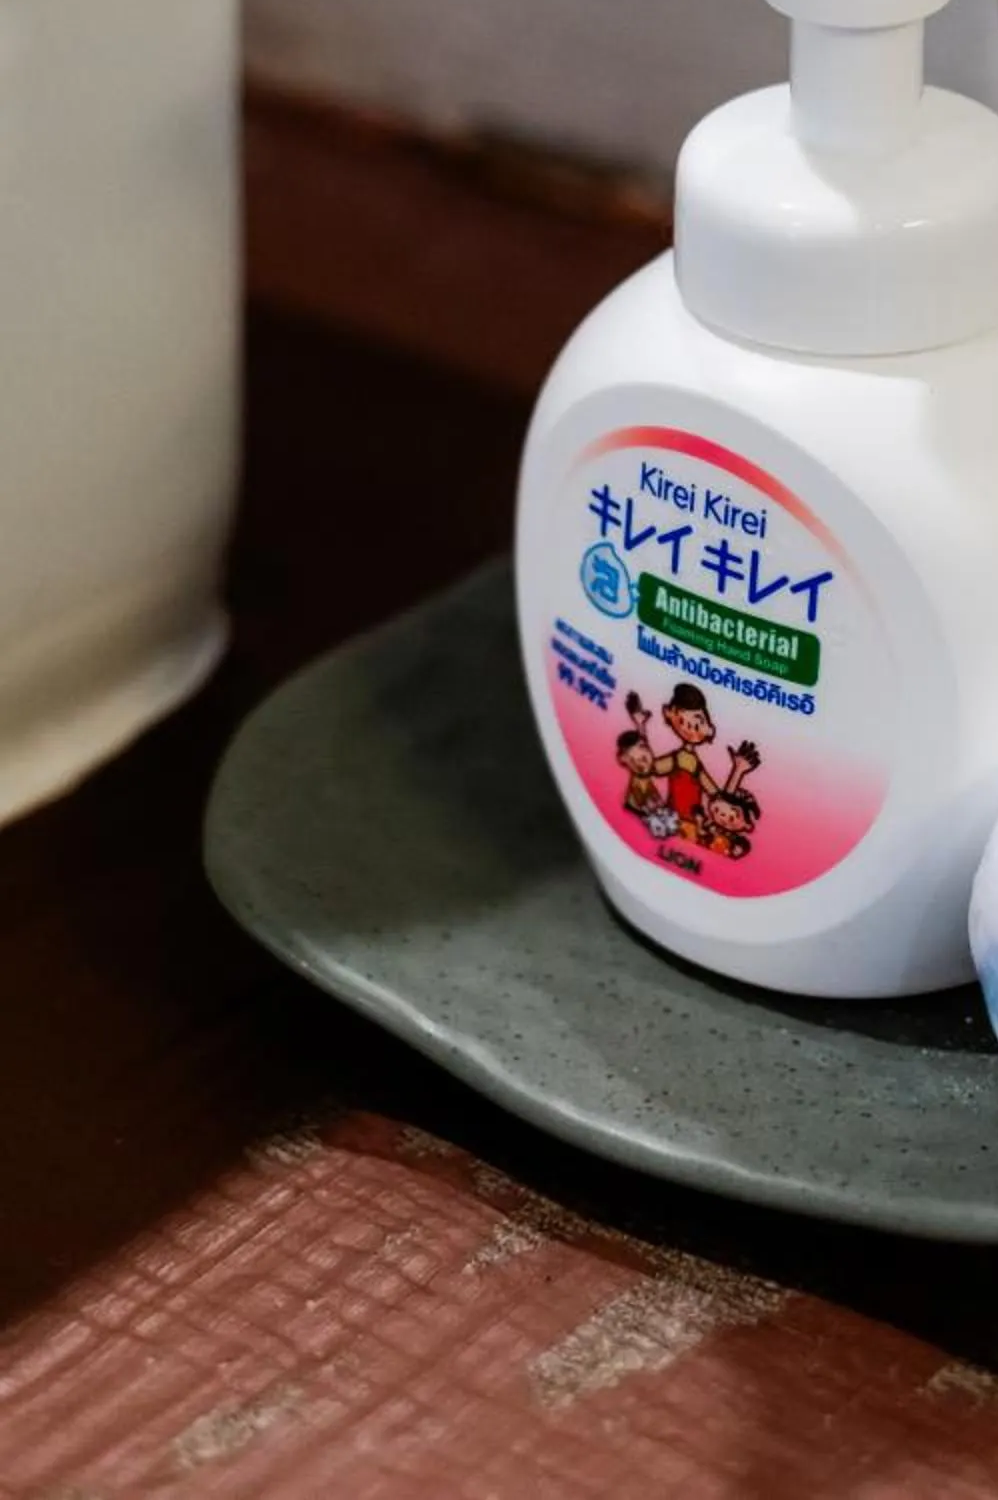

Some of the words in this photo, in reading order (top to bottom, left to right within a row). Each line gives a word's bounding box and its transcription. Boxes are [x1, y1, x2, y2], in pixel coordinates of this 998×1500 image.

[639, 461, 697, 513] Kirei
[703, 489, 767, 539] Kirei
[655, 586, 799, 661] Antibacterial
